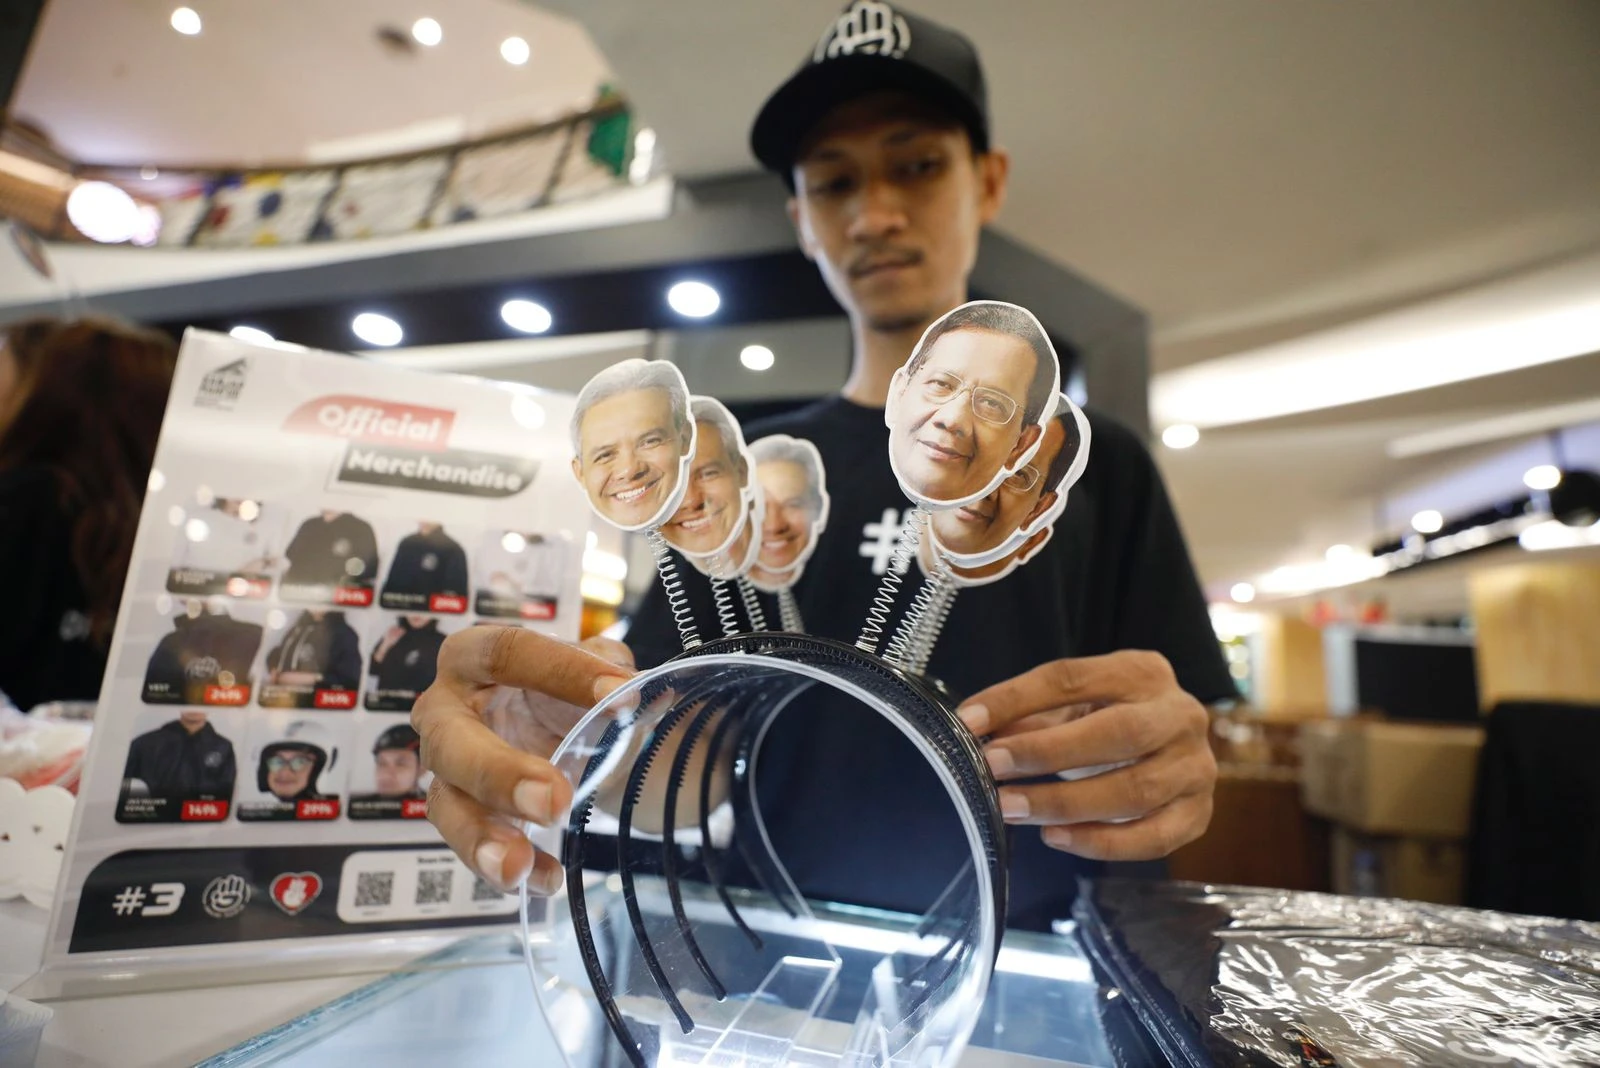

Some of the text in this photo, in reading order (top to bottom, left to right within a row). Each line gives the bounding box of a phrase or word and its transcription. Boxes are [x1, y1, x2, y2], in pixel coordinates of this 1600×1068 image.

[318, 403, 442, 442] Official
[347, 449, 523, 491] Merchandise
[112, 882, 186, 917] #3
